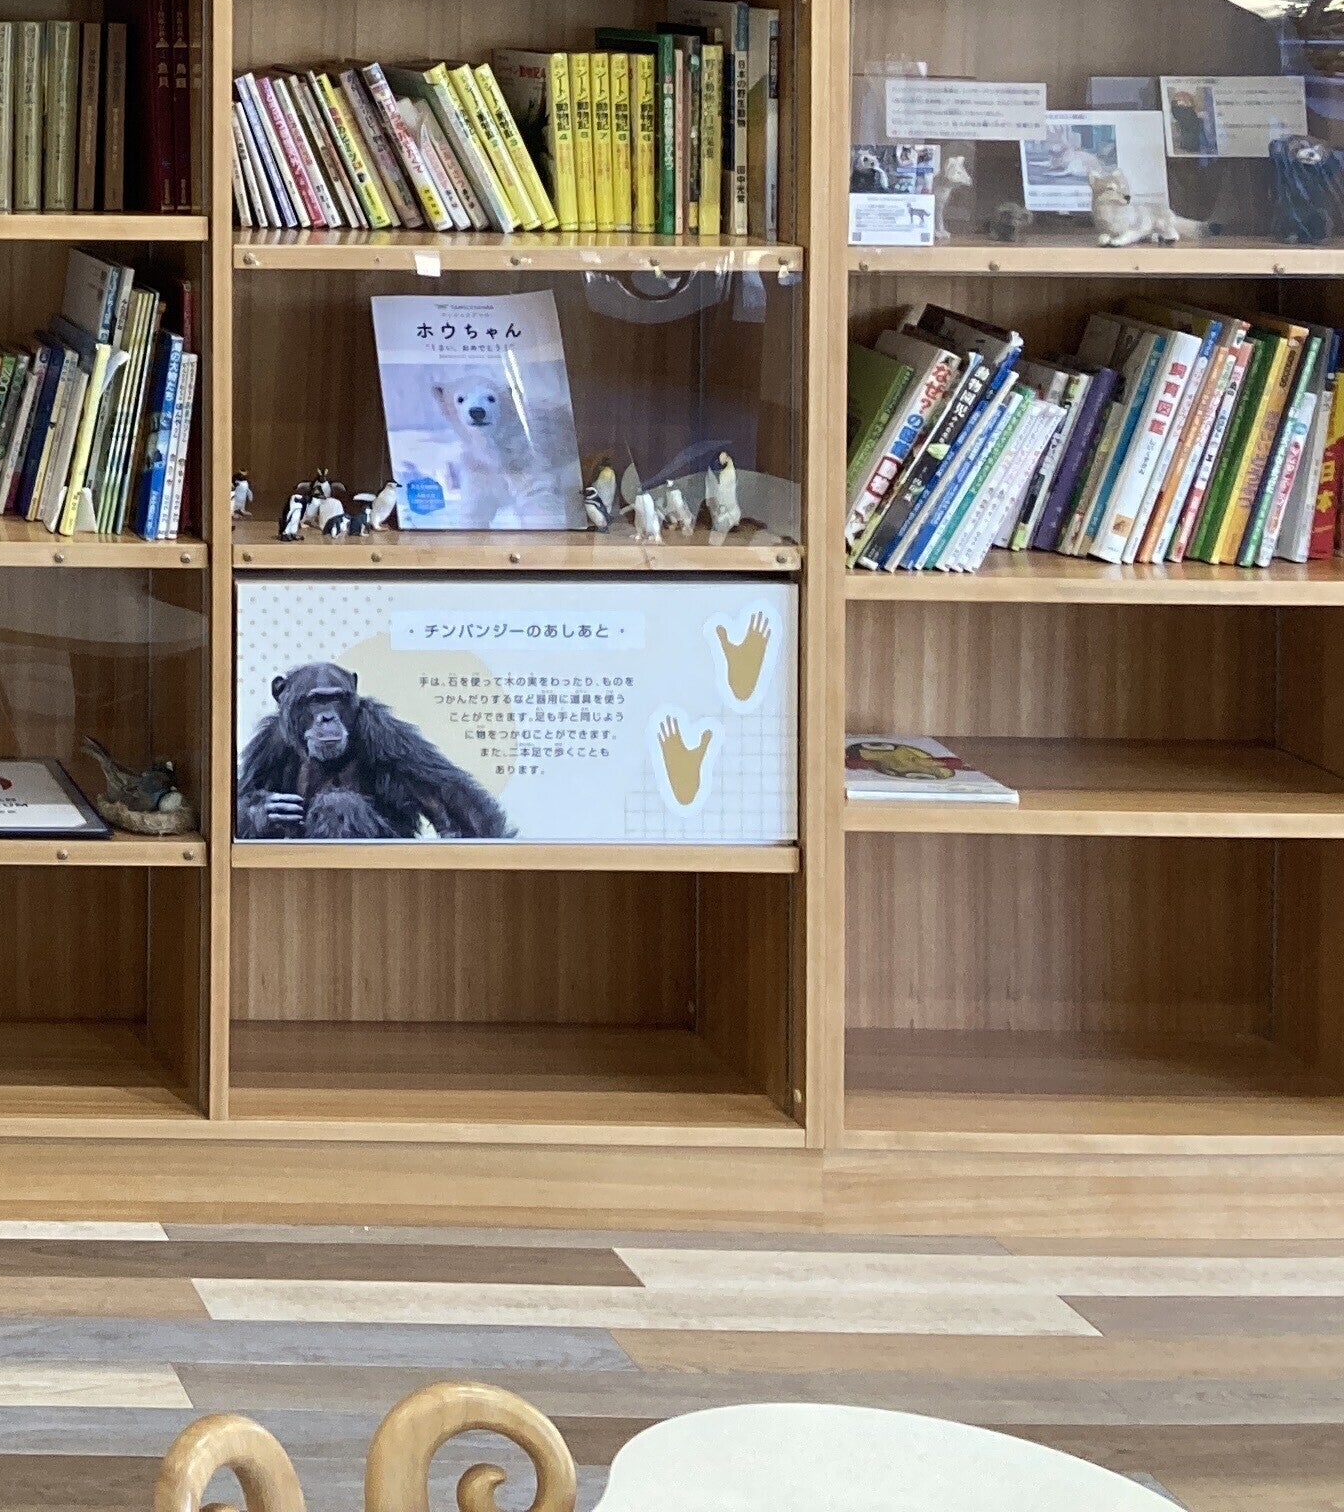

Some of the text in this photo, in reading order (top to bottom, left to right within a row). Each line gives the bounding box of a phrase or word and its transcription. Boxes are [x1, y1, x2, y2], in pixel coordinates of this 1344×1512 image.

[416, 322, 522, 340] ホウちゃん
[425, 622, 610, 639] チンパンジーのあしあと
[495, 764, 545, 775] あります。
